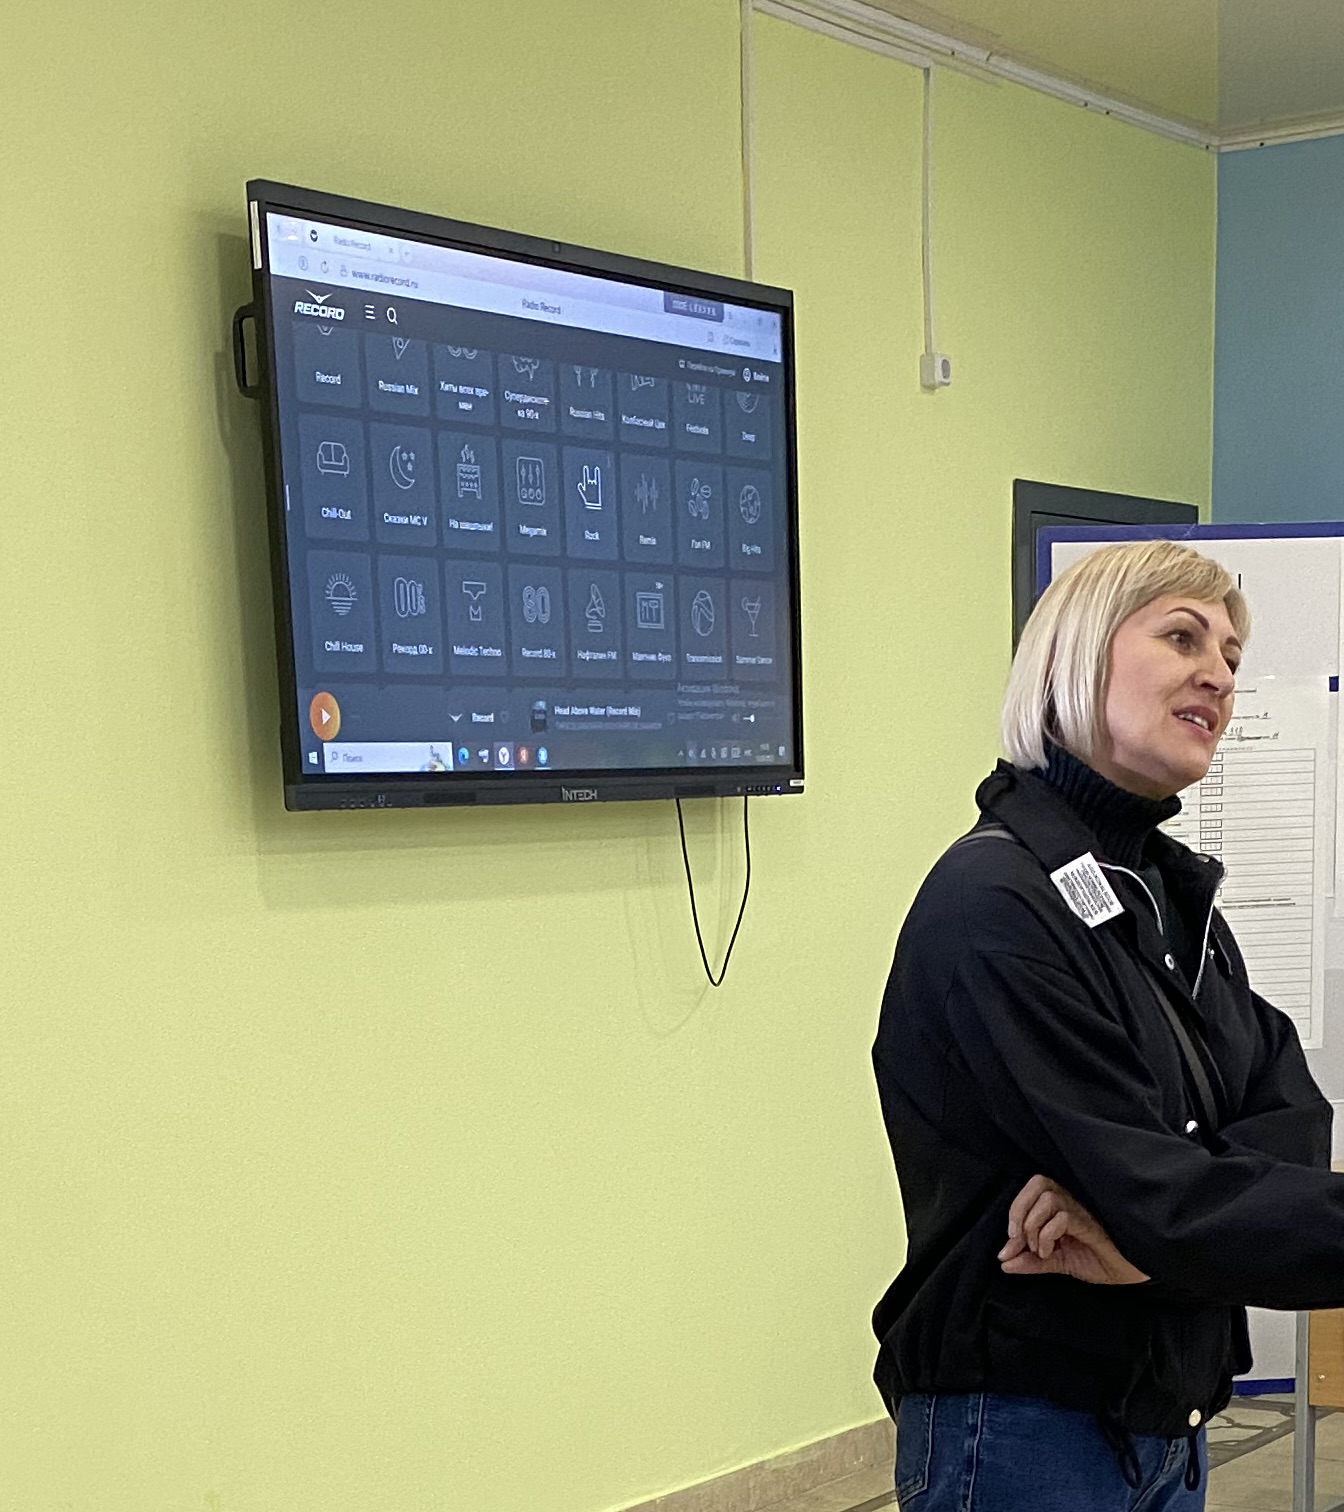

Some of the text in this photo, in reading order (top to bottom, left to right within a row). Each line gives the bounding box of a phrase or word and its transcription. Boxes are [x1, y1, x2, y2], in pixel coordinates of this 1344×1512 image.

[351, 270, 419, 289] www.radiorecord.ru
[294, 300, 345, 321] RECORD
[522, 297, 562, 315] Radio Record
[315, 371, 342, 385] Record
[378, 380, 419, 396] Russian Mix
[321, 507, 352, 520] Chill-Out
[383, 512, 409, 526] Сказки
[449, 518, 459, 529] На
[584, 530, 600, 541] Rock
[324, 640, 364, 653] Chill House
[392, 643, 419, 655] Рекорд
[453, 645, 502, 657] Melodic Techno
[521, 647, 543, 658] Record
[607, 650, 617, 660] FM
[554, 705, 570, 716] Head
[570, 705, 589, 716] Above
[589, 706, 606, 716] Water
[606, 706, 628, 717] (Record
